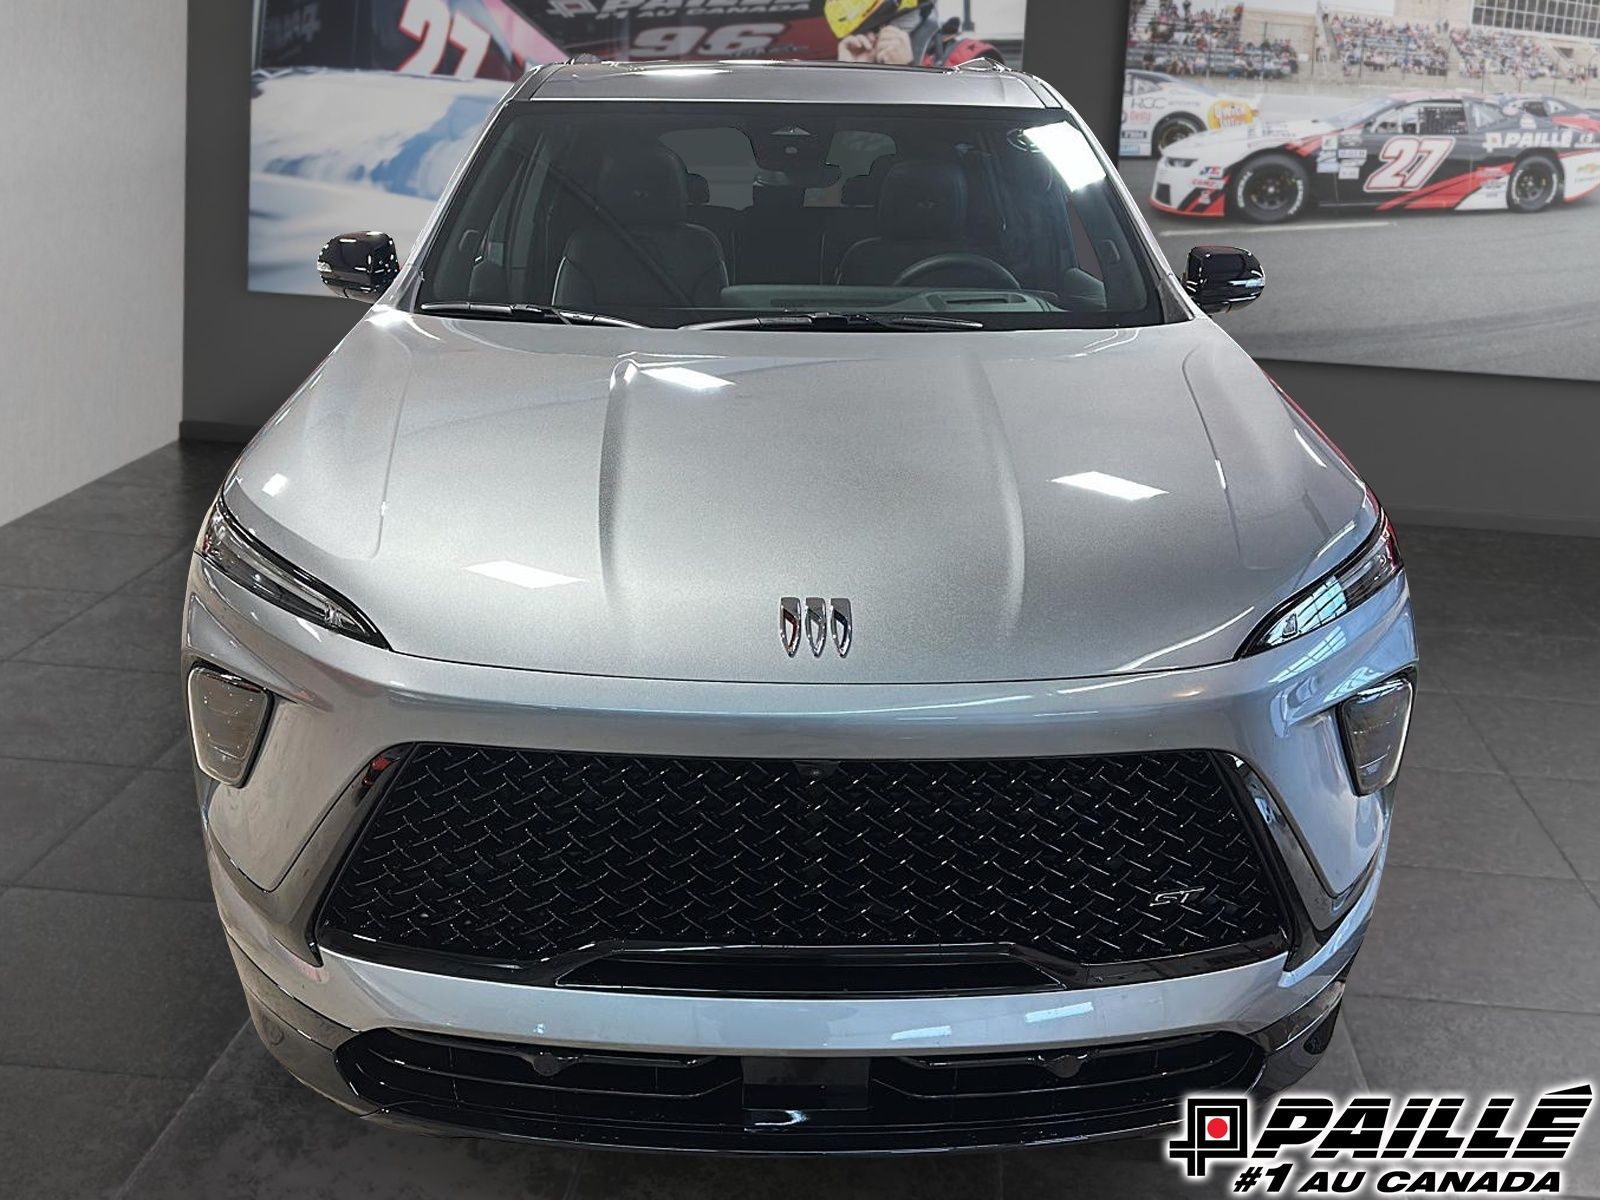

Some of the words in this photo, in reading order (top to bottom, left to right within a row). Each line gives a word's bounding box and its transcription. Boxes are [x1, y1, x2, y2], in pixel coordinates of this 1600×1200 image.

[686, 3, 810, 16] CANADA
[398, 0, 491, 79] 27
[628, 23, 786, 57] 96
[1363, 135, 1456, 192] 27
